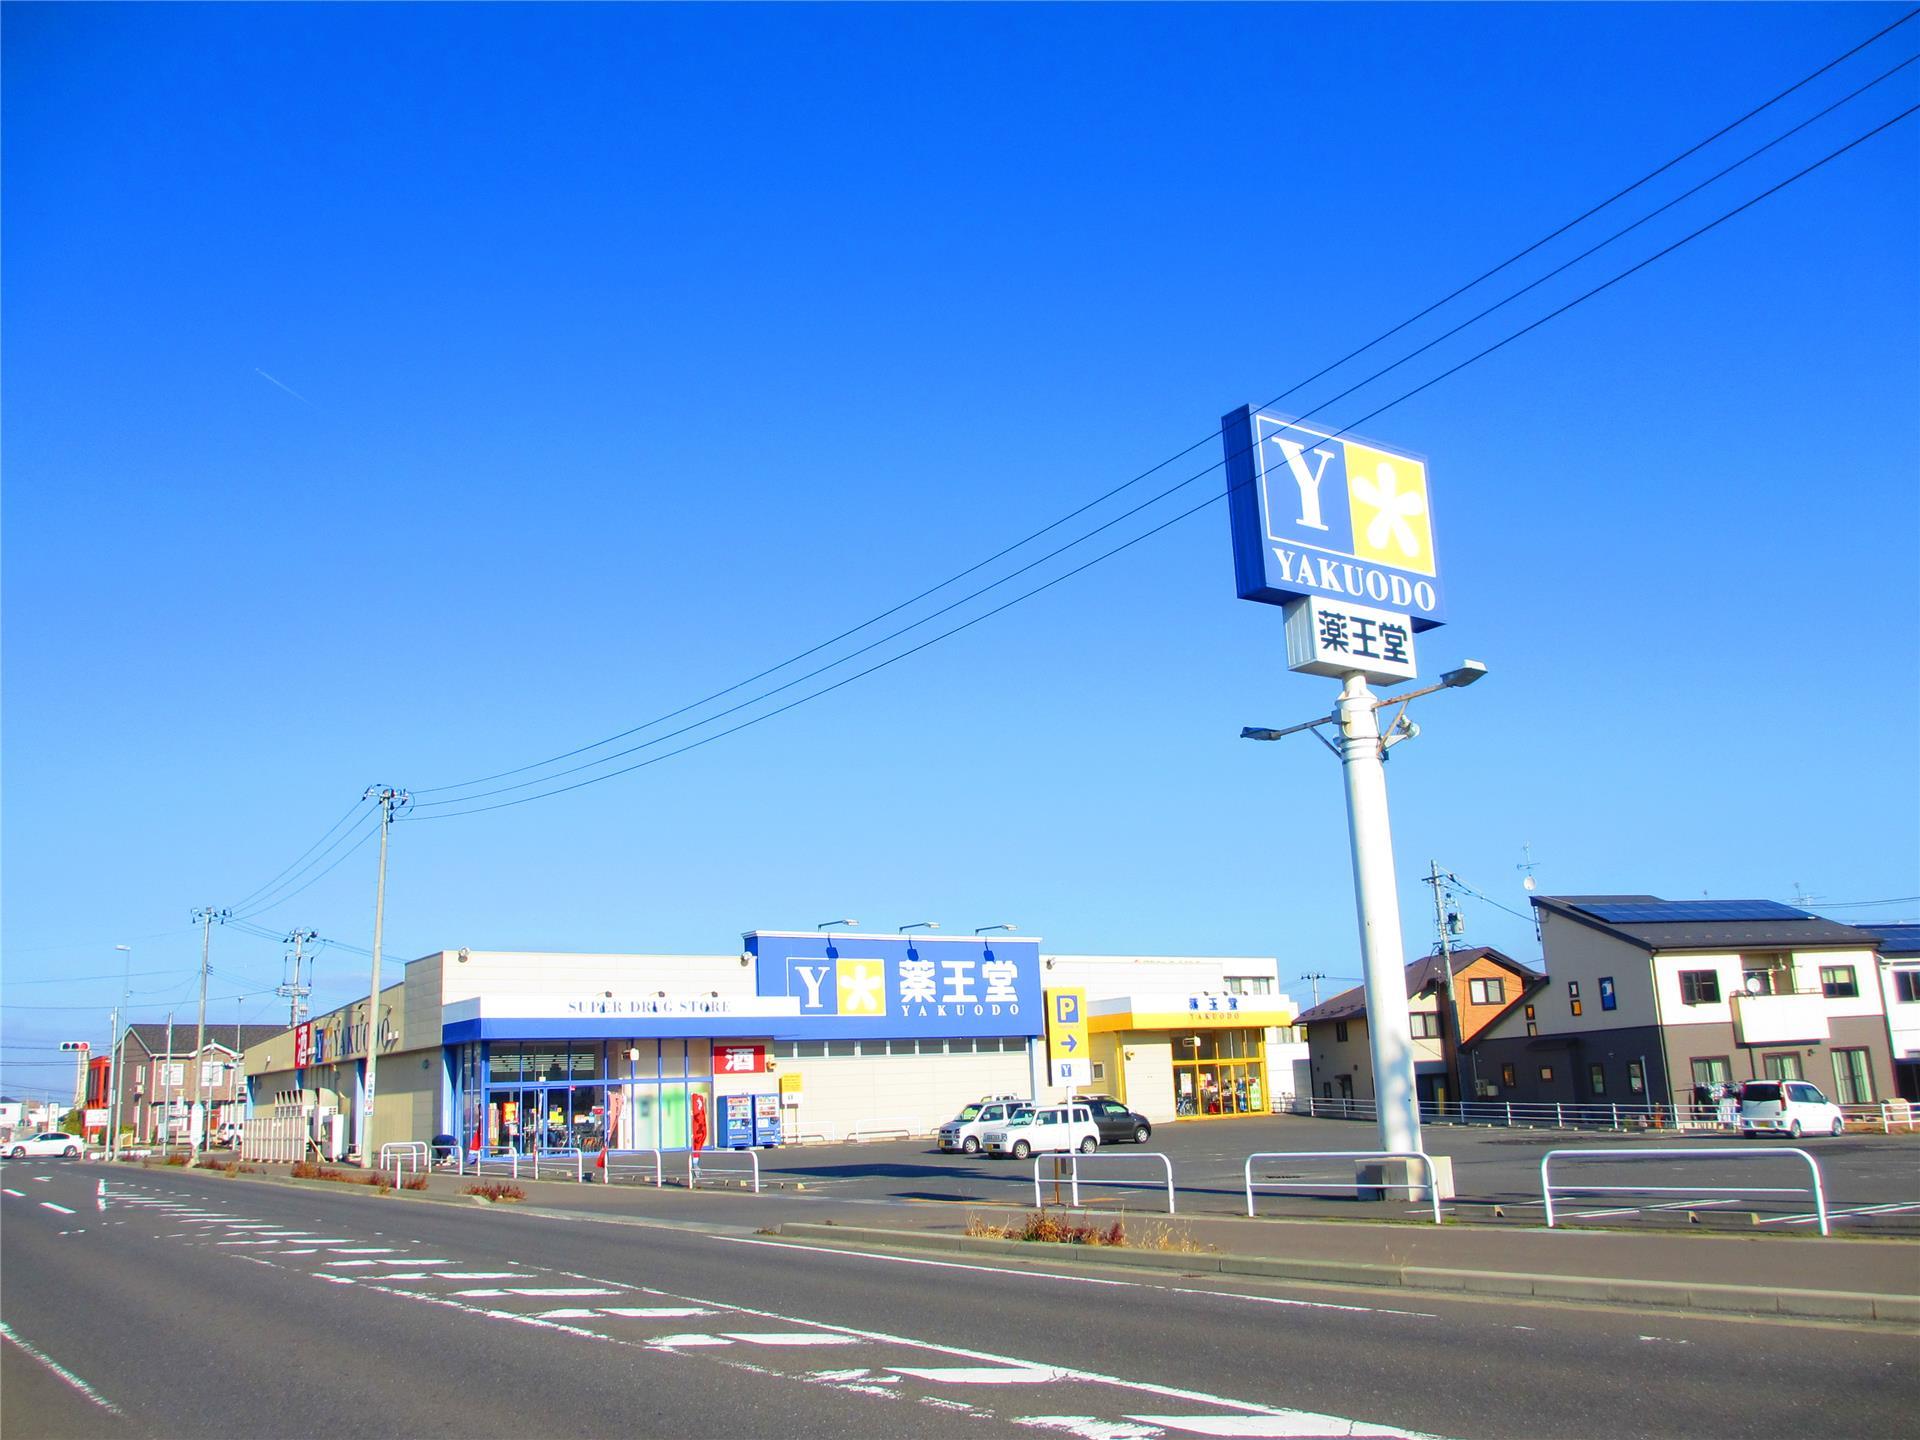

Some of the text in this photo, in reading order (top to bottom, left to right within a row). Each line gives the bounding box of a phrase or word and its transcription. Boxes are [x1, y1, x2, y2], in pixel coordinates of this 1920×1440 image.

[1271, 436, 1335, 531] Y
[1272, 548, 1436, 611] YAKUODO
[1318, 610, 1409, 664] 薬王堂
[795, 966, 830, 1008] Y
[899, 960, 1018, 1003] 薬王堂
[568, 1001, 731, 1013] SUPER DRUG STORE
[901, 1003, 1019, 1016] YAKUODO
[1060, 997, 1075, 1021] P
[725, 1048, 754, 1071] 酒
[1062, 1064, 1071, 1076] Y
